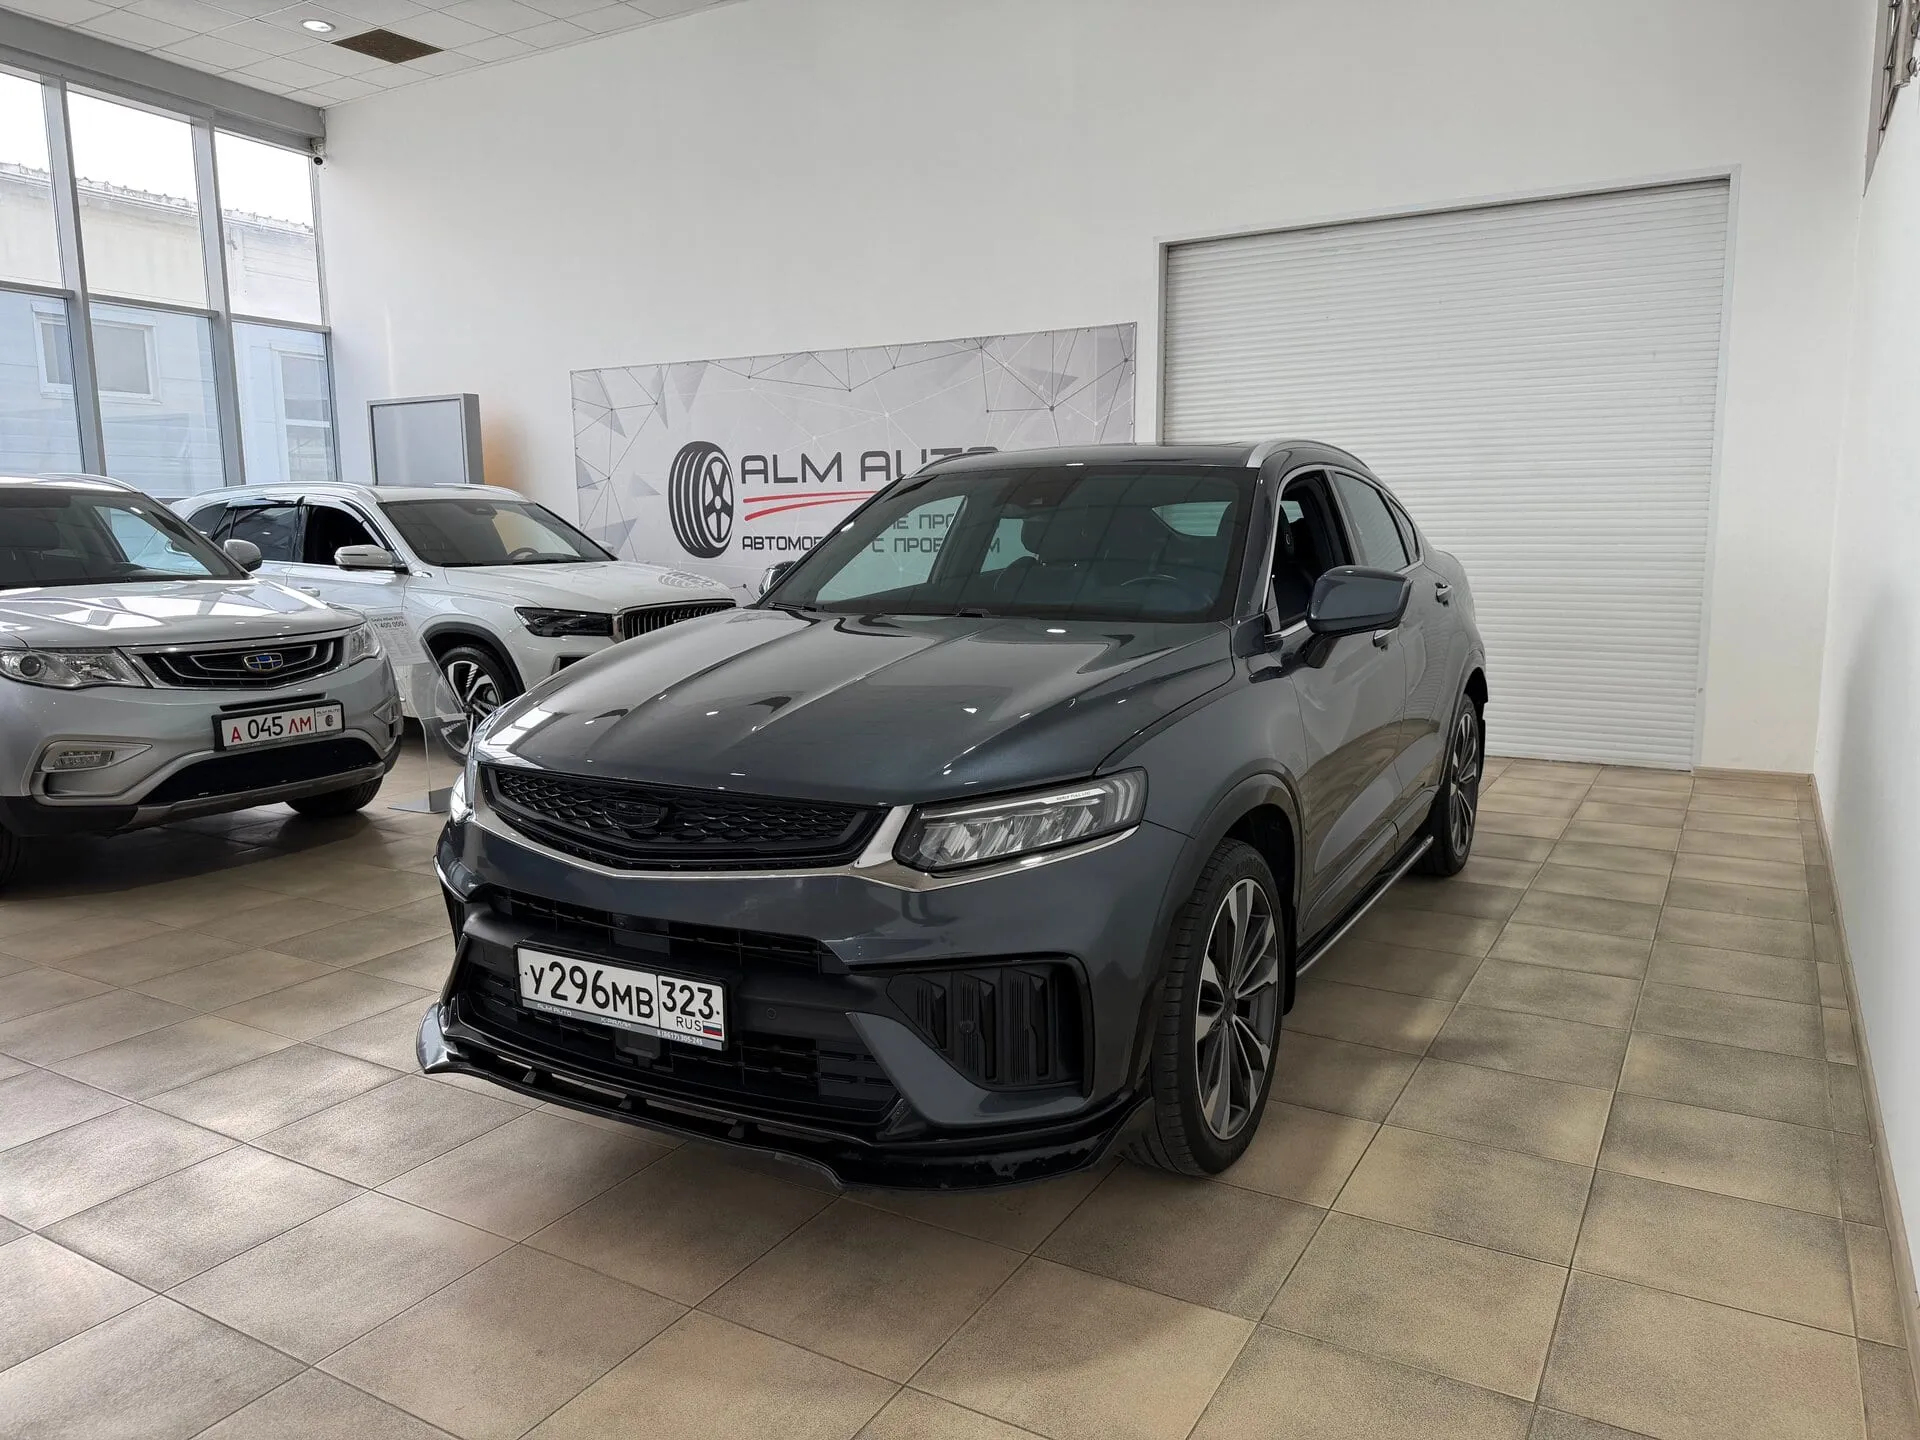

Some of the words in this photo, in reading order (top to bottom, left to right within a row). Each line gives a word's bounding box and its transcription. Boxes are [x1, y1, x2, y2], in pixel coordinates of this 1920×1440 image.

[741, 452, 843, 484] ALM
[860, 446, 999, 482] AU
[248, 715, 284, 740] 045
[529, 961, 654, 1020] У296МВ
[661, 980, 714, 1020] 323
[676, 1016, 702, 1032] RUS
